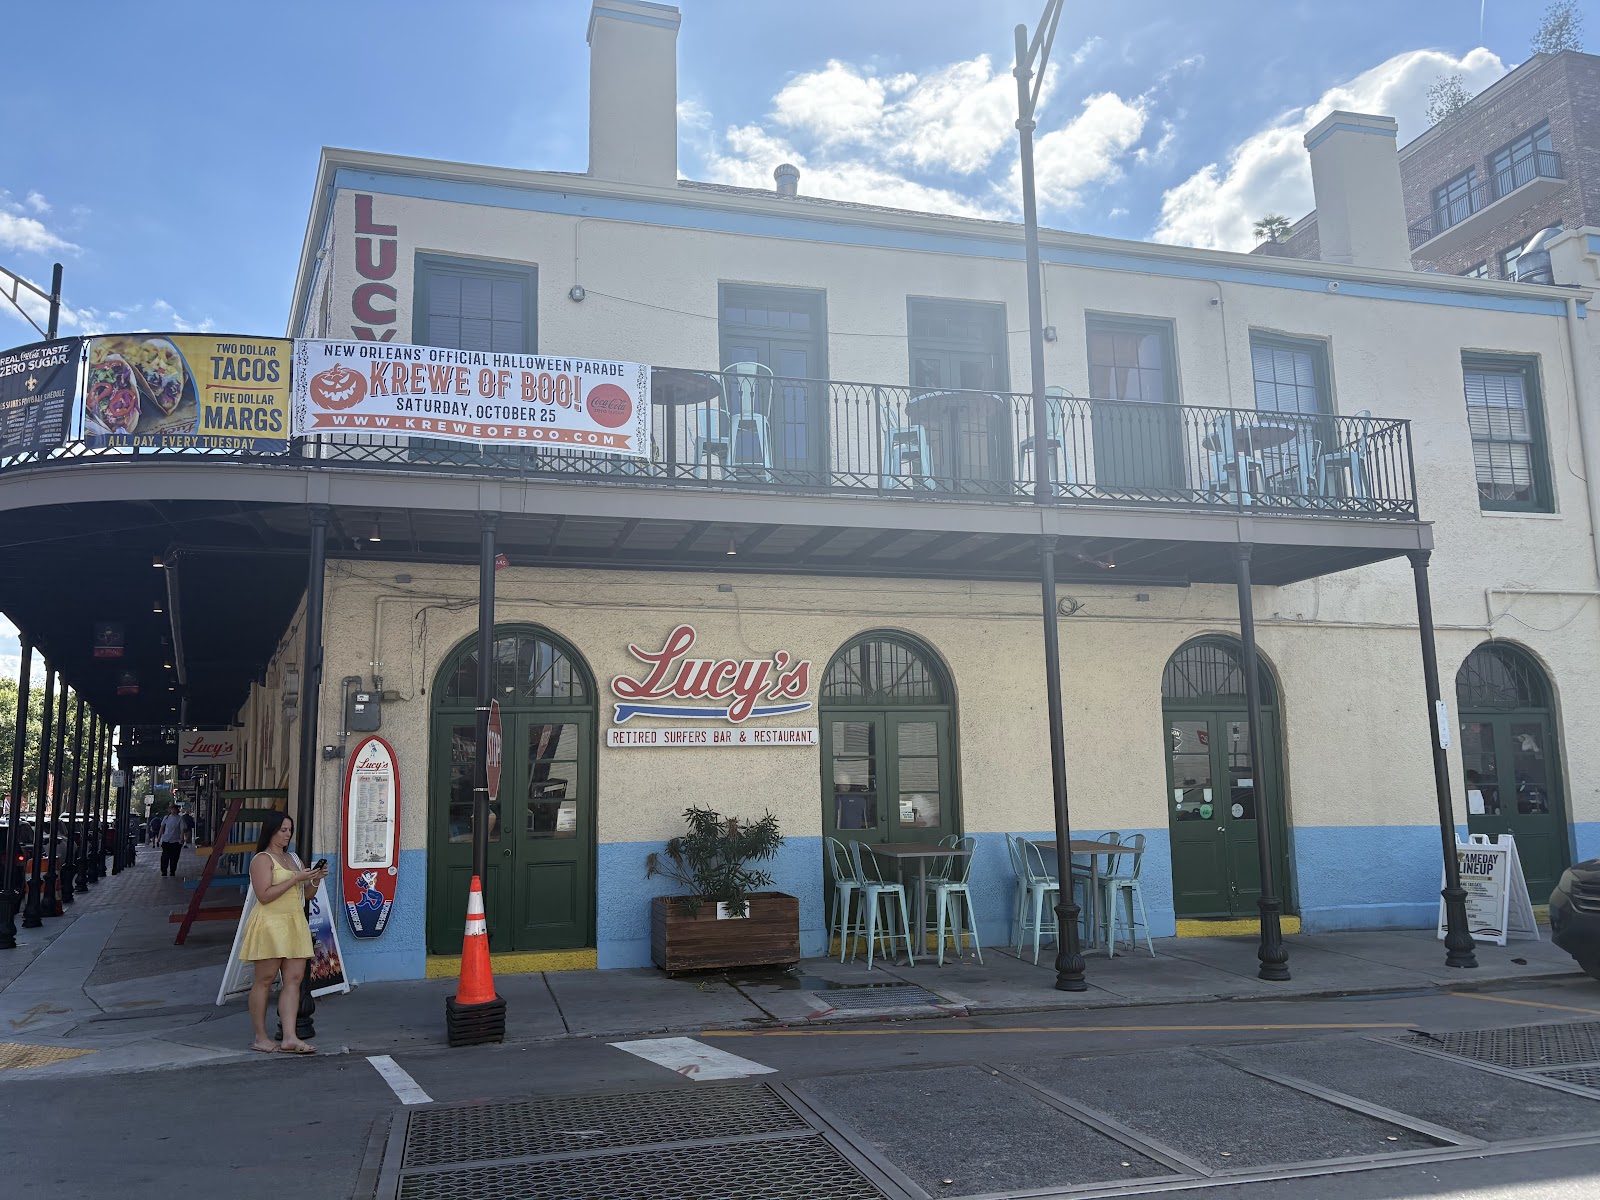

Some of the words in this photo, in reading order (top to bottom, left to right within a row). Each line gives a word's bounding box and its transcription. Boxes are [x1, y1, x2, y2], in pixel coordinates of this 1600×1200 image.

[0, 355, 20, 366] REAL
[41, 345, 71, 357] TASTE
[216, 343, 238, 355] TWO
[239, 344, 276, 357] DOLLAR
[324, 344, 355, 358] NEW
[359, 346, 425, 361] ORLEANS'
[429, 349, 489, 366] OFFICIAL
[493, 354, 572, 372] HALLOWEEN
[576, 361, 624, 377] PARADE
[0, 362, 26, 377] ZERO
[210, 356, 280, 383] TACOS
[370, 361, 471, 397] KREWE
[478, 368, 513, 400] OF
[520, 371, 582, 412] BOO!
[213, 392, 234, 405] FIVE
[235, 393, 274, 406] DOLLAR
[204, 405, 283, 432] MARGS
[396, 398, 472, 418] SATURDAY,
[476, 405, 536, 421] OCTOBER
[541, 408, 556, 423] 25
[333, 415, 614, 445] WWW.KREWEOFBOO.COM
[108, 435, 129, 447] ALL
[133, 435, 157, 448] DAY,
[161, 435, 200, 448] EVERY
[203, 437, 255, 450] TUESDAY
[611, 623, 812, 723] Lucy's
[182, 736, 234, 759] Lucy's
[613, 731, 657, 744] RETIRED
[664, 730, 707, 743] SURFERS
[713, 730, 732, 743] BAR
[739, 730, 747, 742] &
[754, 730, 813, 743] RESTAURANT
[356, 758, 389, 772] Lucy's
[1462, 853, 1498, 864] AMEDAY
